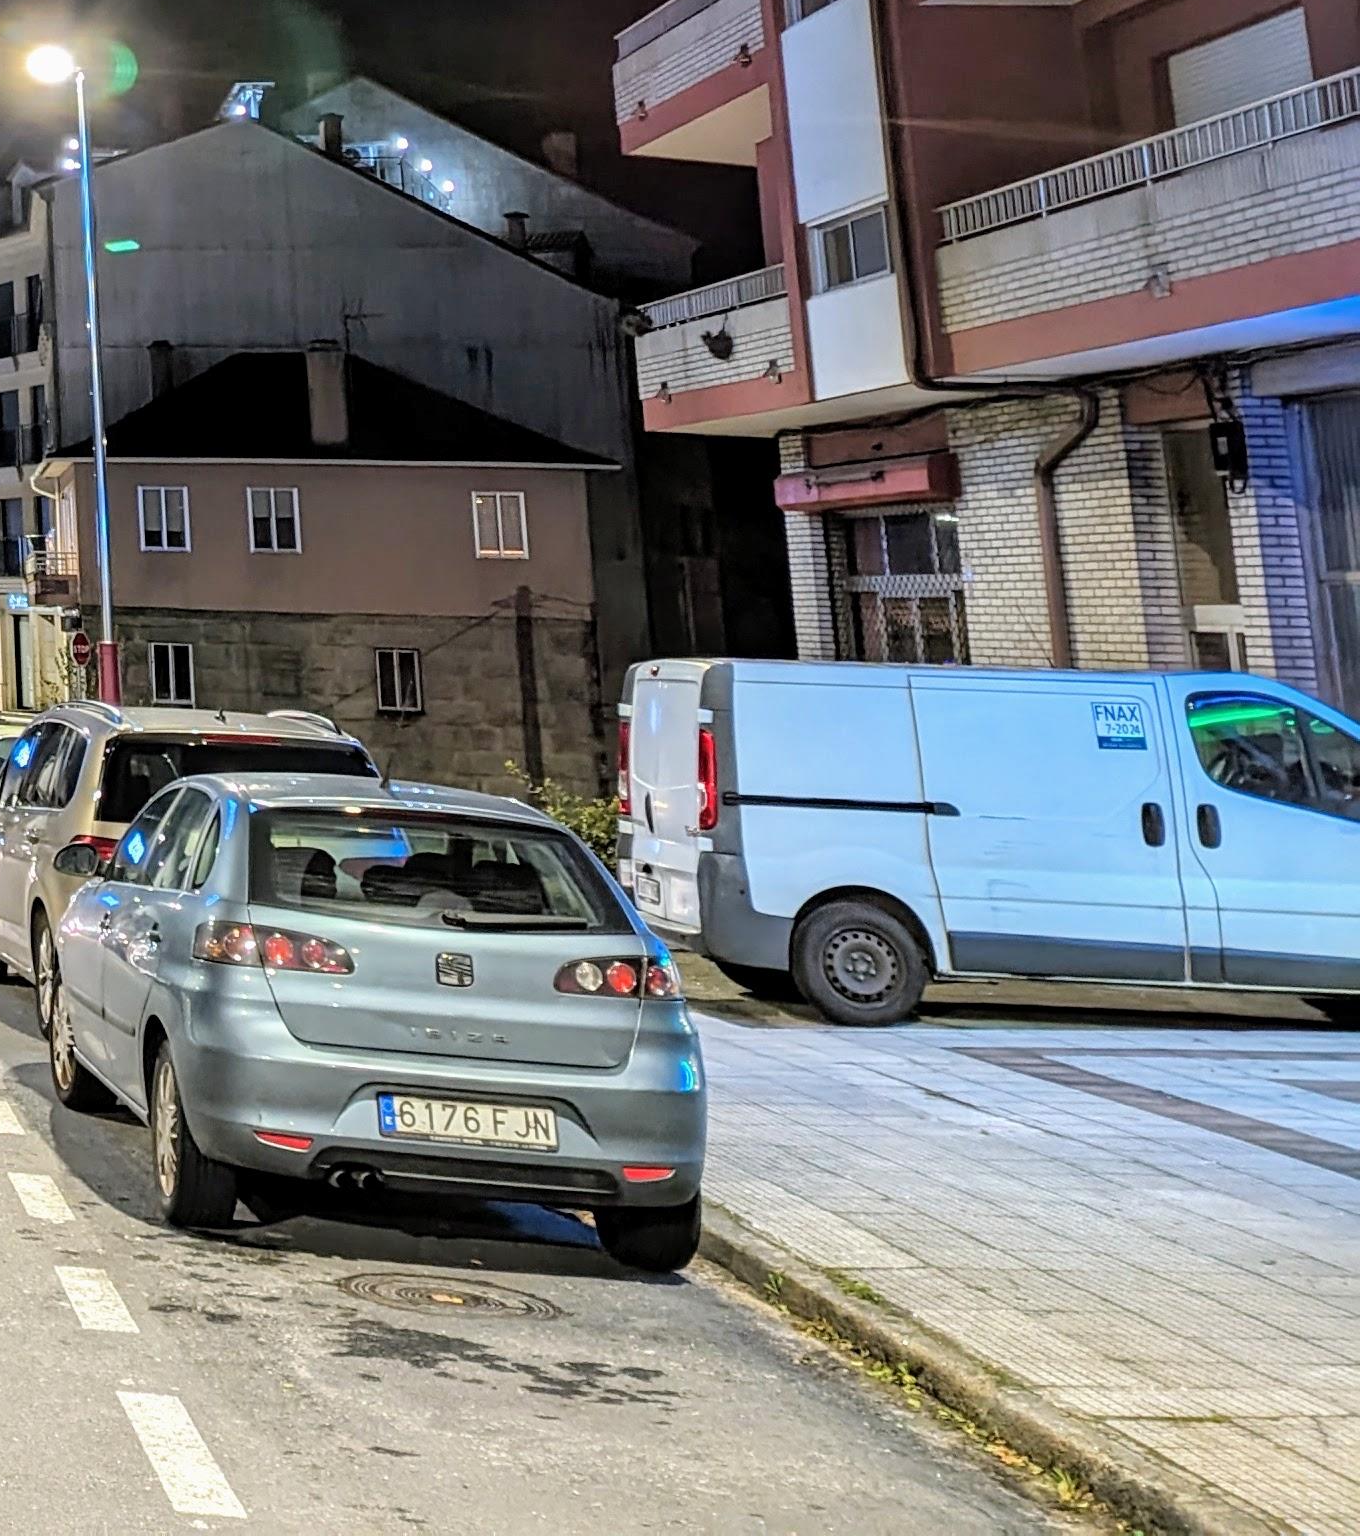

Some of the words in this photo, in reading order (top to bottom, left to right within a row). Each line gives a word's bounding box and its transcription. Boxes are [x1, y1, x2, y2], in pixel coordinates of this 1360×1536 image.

[73, 644, 90, 654] STOP
[1095, 705, 1139, 722] FNAX
[1105, 723, 1141, 735] 7-2024
[410, 1026, 511, 1044] IBIZA
[399, 1100, 481, 1134] 6176
[492, 1107, 550, 1141] FJN
